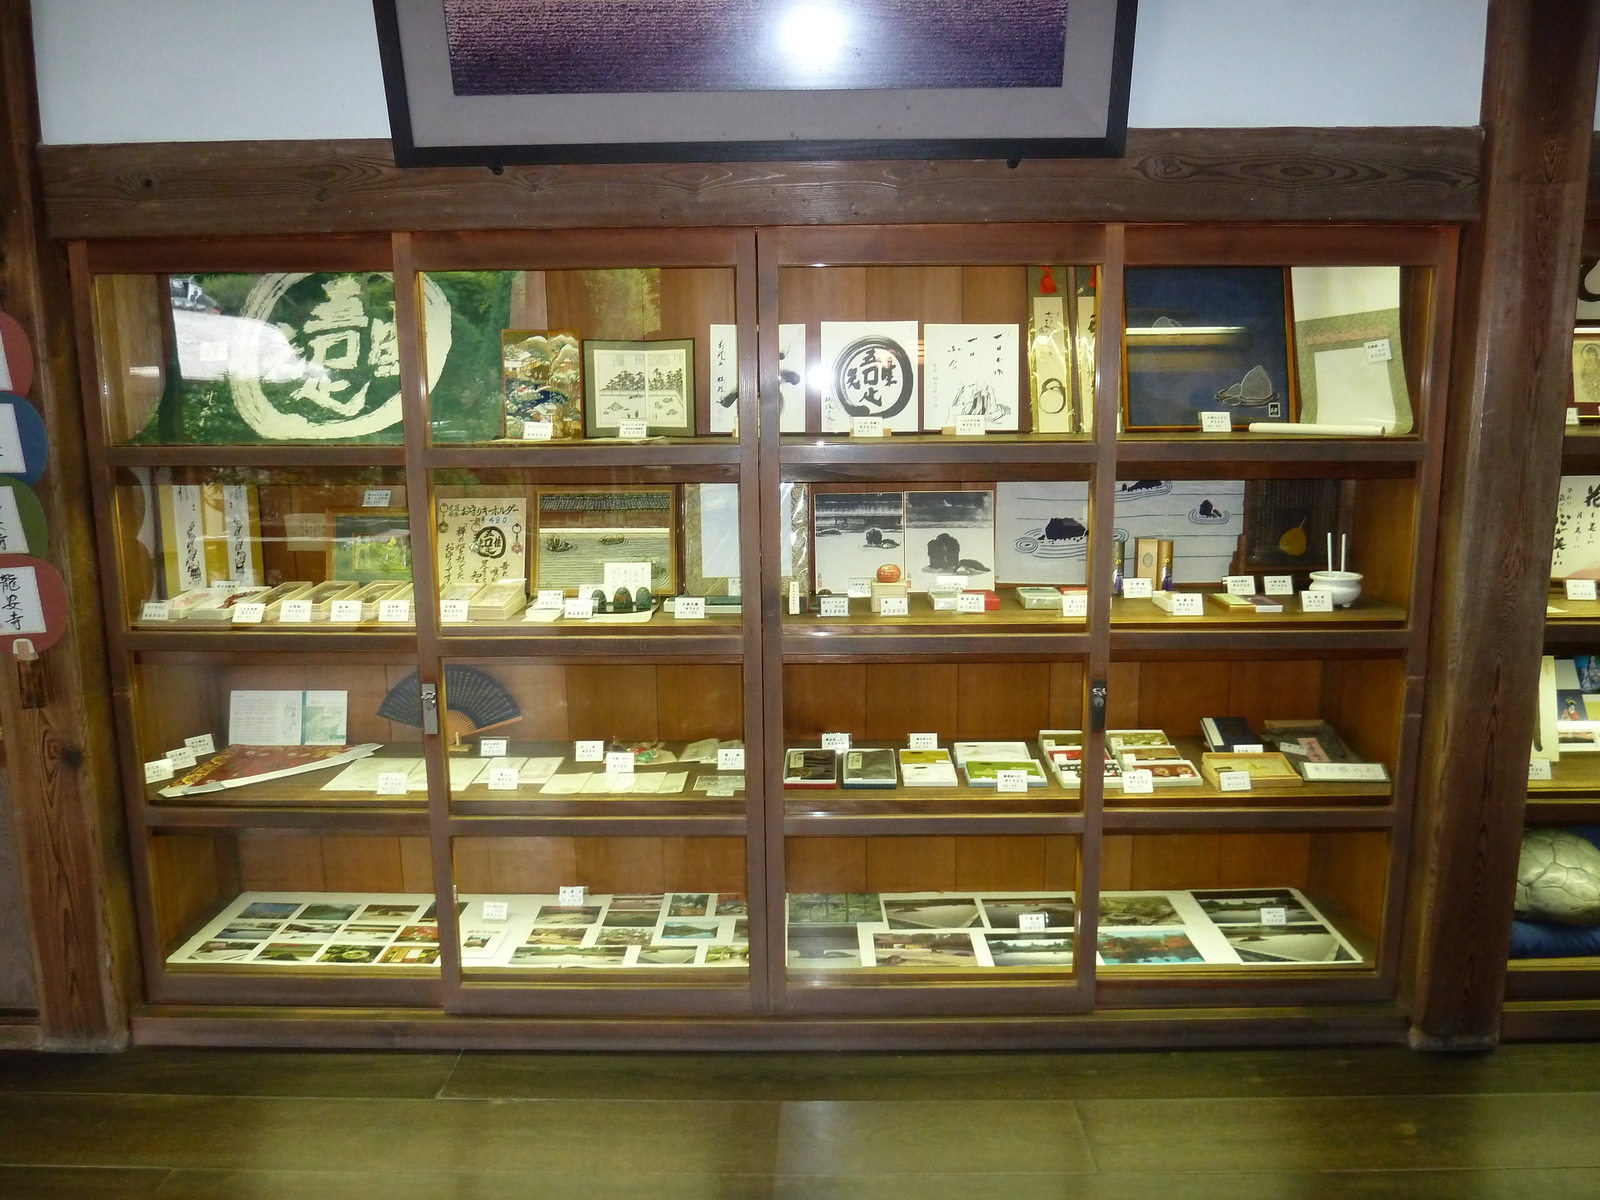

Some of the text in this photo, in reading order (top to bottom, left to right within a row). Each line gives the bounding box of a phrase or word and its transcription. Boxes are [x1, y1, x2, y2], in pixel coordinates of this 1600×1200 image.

[488, 516, 508, 524] 480
[0, 573, 24, 631] 龍安寺
